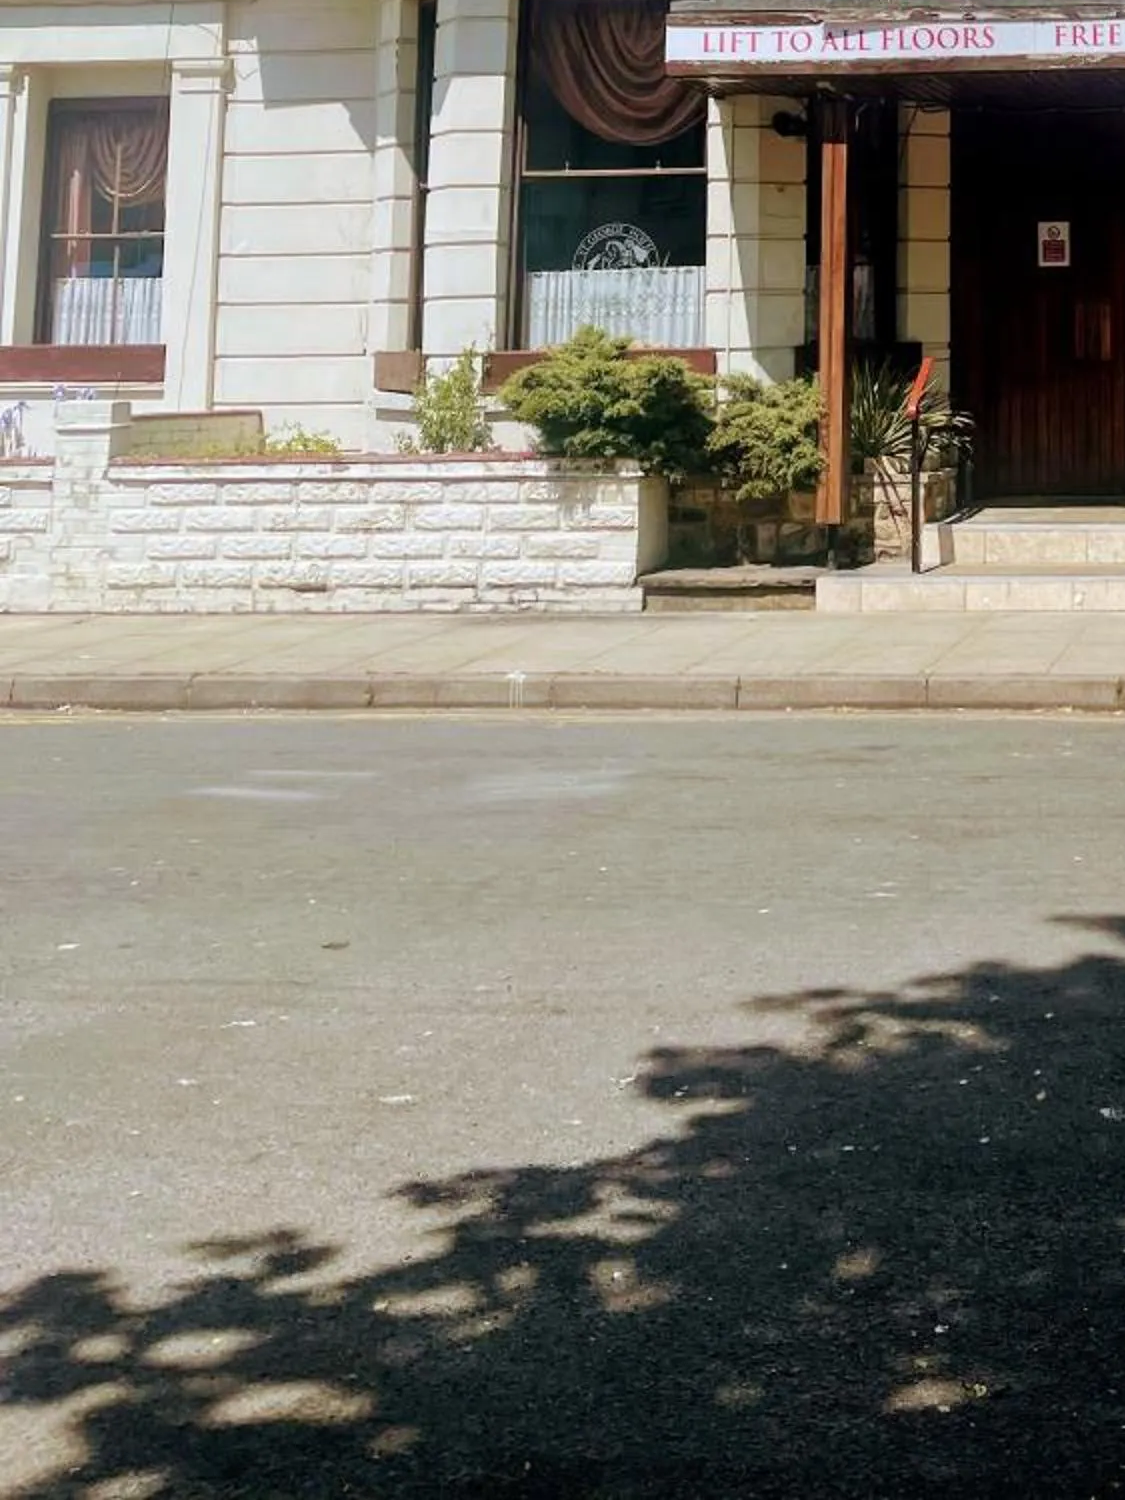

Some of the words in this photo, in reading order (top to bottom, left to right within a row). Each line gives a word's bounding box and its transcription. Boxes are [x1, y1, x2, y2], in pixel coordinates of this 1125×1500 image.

[703, 30, 763, 52] LIFT
[774, 30, 813, 52] TO
[823, 28, 876, 51] ALL
[882, 25, 996, 50] FLOORS
[1055, 22, 1122, 47] FREE
